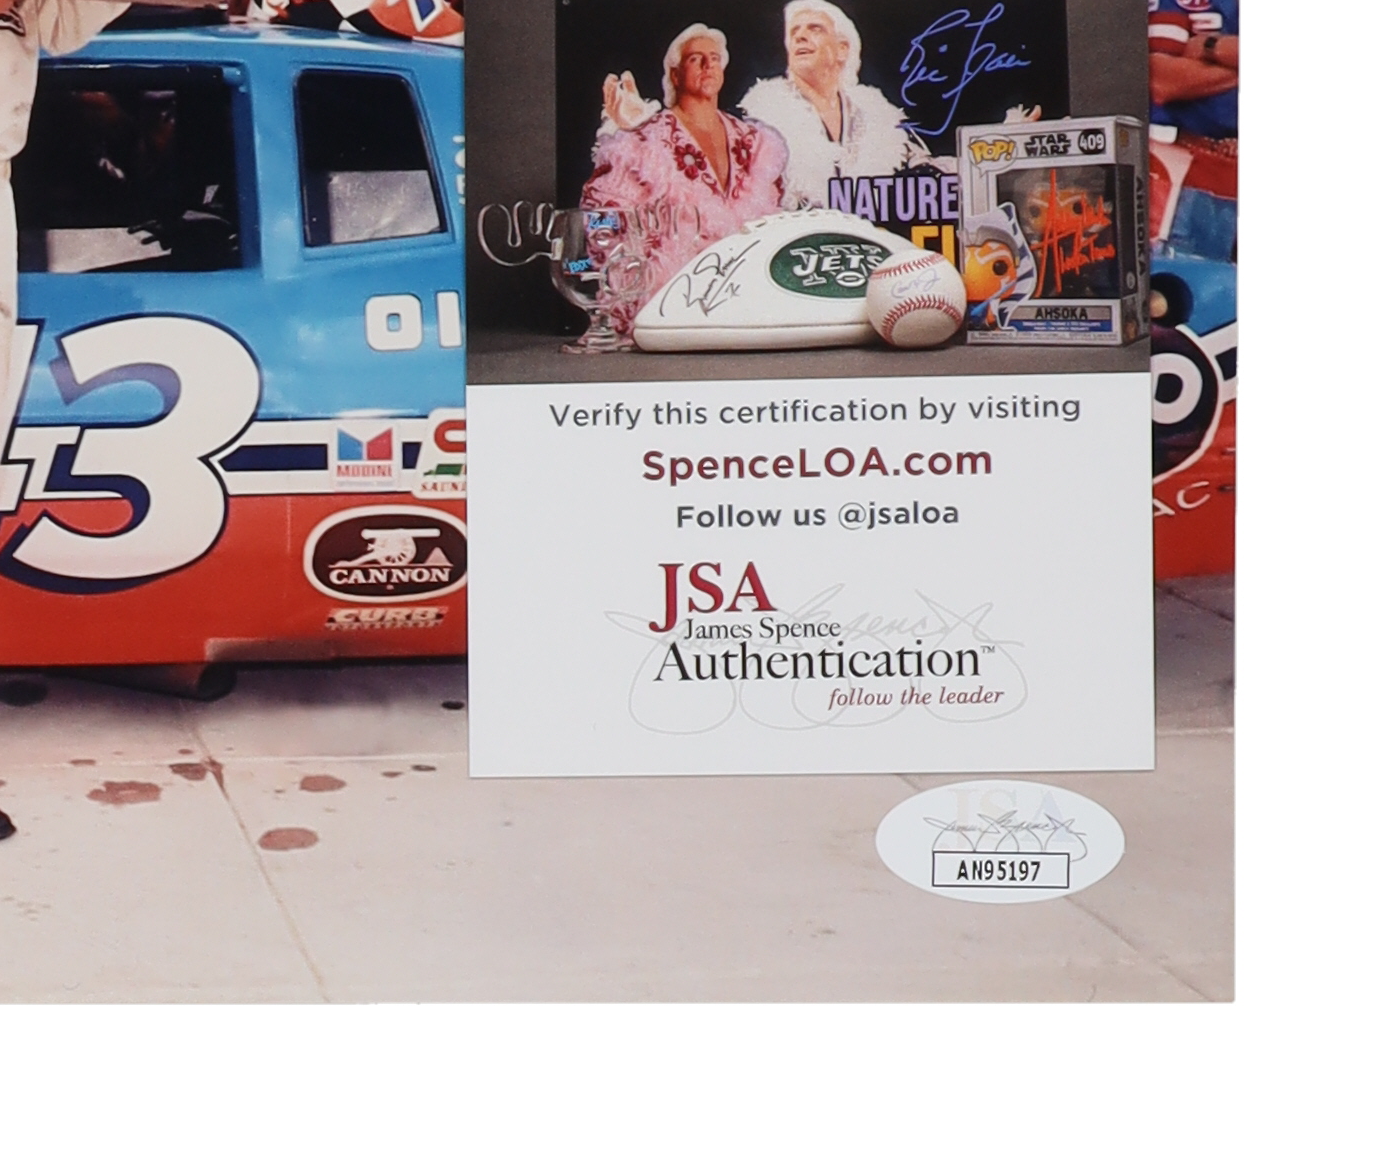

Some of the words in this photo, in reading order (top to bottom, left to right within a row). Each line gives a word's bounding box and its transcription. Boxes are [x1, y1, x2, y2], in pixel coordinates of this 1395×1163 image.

[968, 139, 1016, 163] POP!
[1025, 132, 1071, 145] STAR
[1025, 142, 1071, 158] WARS
[1078, 134, 1105, 153] 409
[829, 176, 958, 223] NATURE
[1034, 306, 1089, 321] AHSOKA
[550, 402, 642, 430] Verify
[653, 400, 707, 426] this
[719, 397, 907, 425] certification
[919, 396, 957, 425] by
[967, 393, 1082, 423] visiting
[642, 447, 993, 487] SpenceLOA.com
[676, 503, 783, 529] Follow
[793, 507, 827, 528] us
[837, 501, 960, 531] @jsaloa
[328, 567, 452, 585] CANNON
[649, 560, 778, 634] JSA
[684, 617, 752, 641] James
[759, 616, 842, 644] Spence
[828, 686, 893, 711] follow
[901, 686, 933, 705] the
[939, 685, 1005, 705] leader
[956, 859, 1042, 882] AN95197
